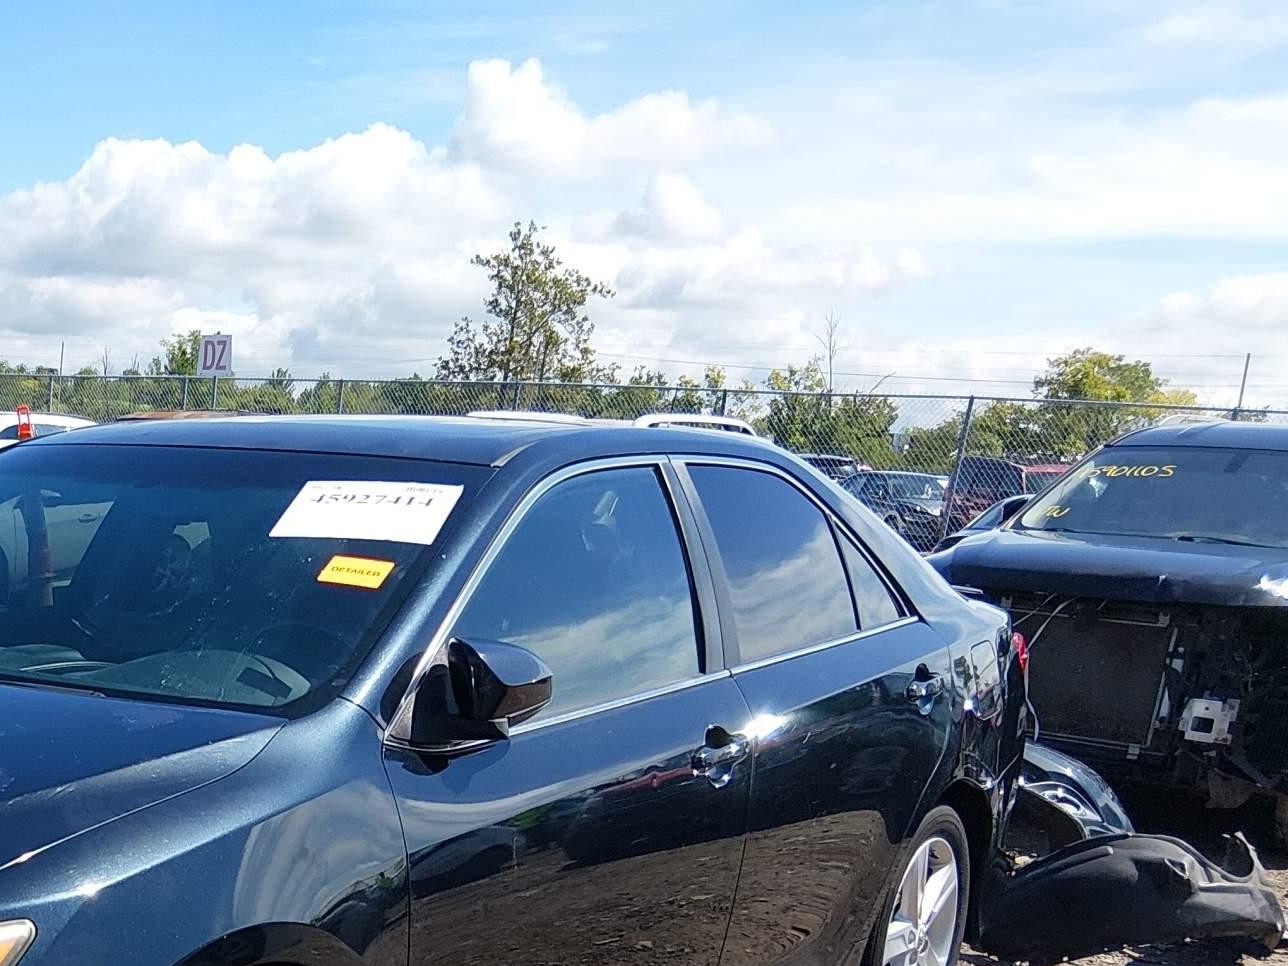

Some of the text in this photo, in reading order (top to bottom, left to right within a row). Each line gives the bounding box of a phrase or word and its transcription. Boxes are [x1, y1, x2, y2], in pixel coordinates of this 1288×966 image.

[203, 340, 227, 370] DZ
[310, 494, 435, 507] 45927414
[331, 566, 381, 577] DETAILED
